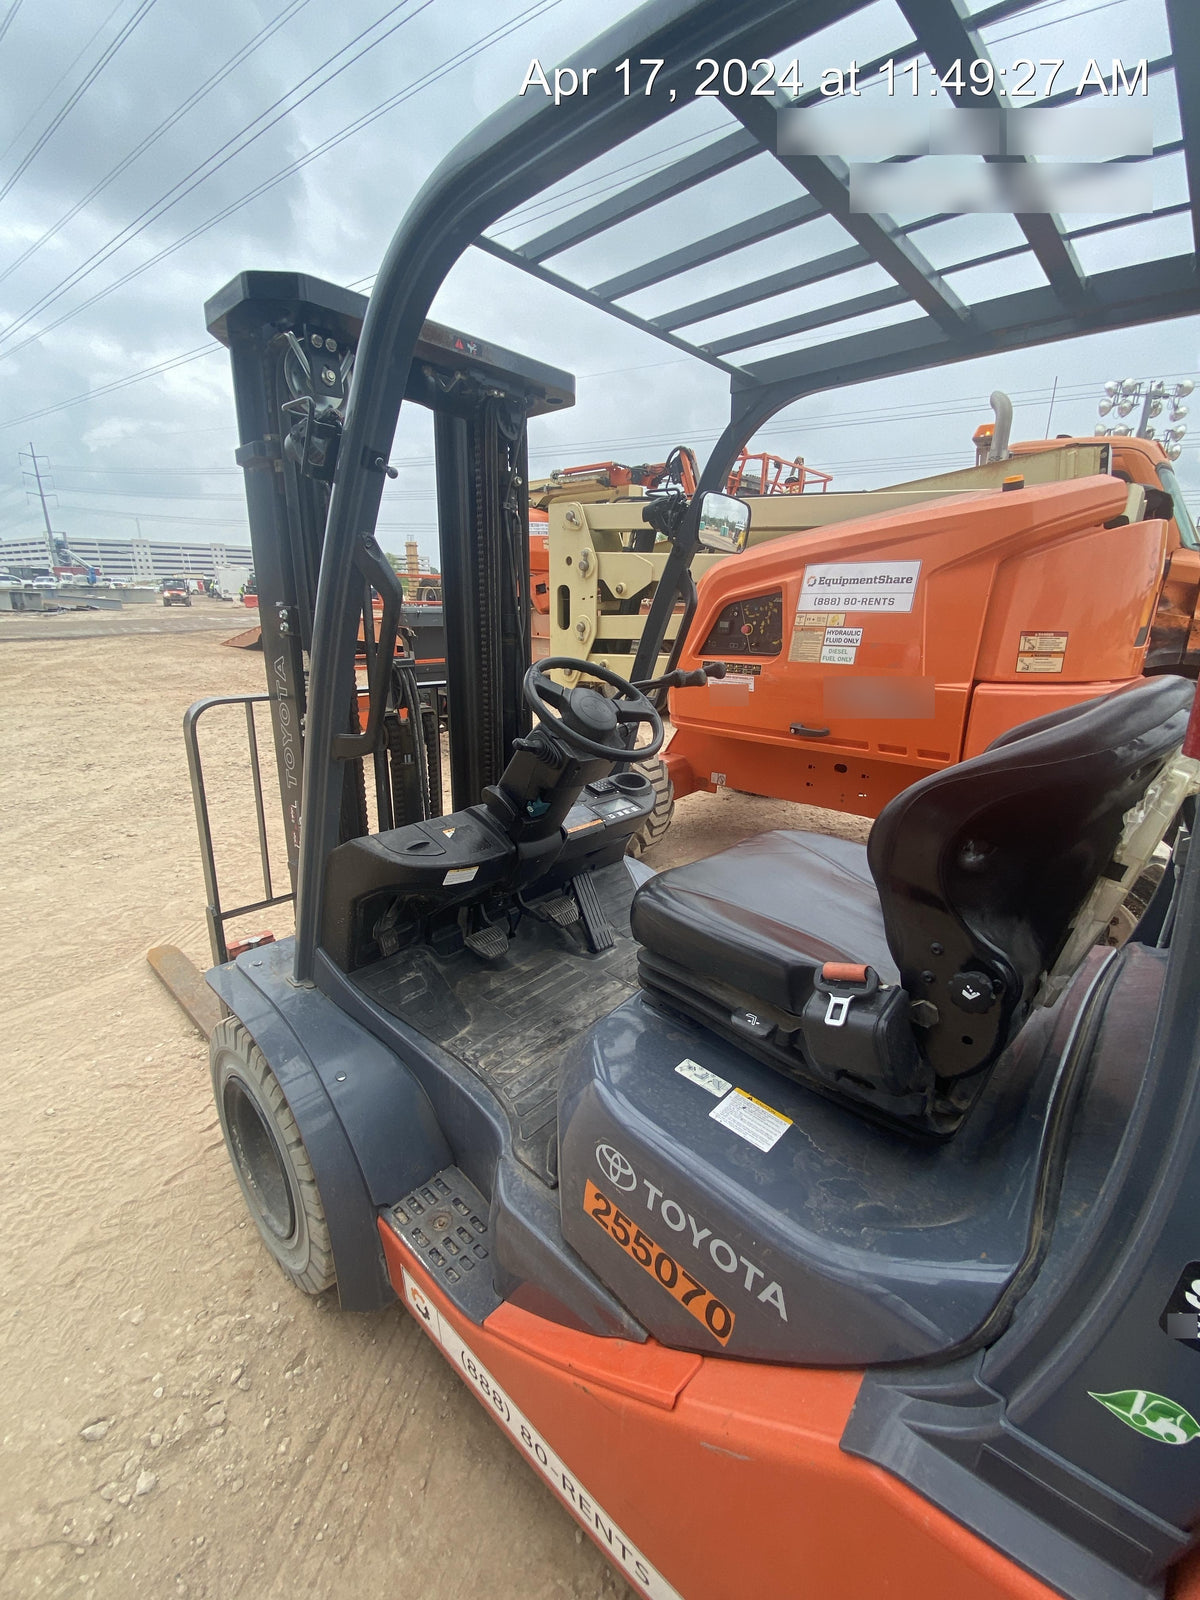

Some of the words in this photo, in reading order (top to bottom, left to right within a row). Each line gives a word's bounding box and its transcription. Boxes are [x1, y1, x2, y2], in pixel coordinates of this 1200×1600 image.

[814, 597, 841, 606] (888)
[844, 597, 895, 606] 80-RENTS
[818, 575, 913, 587] EquipmentShare
[274, 655, 298, 789] TOYOTA
[591, 1192, 732, 1339] 255070
[643, 1178, 788, 1322] TOYOTA
[461, 1350, 511, 1422] (888)
[520, 1424, 650, 1586] 80-RENTS
